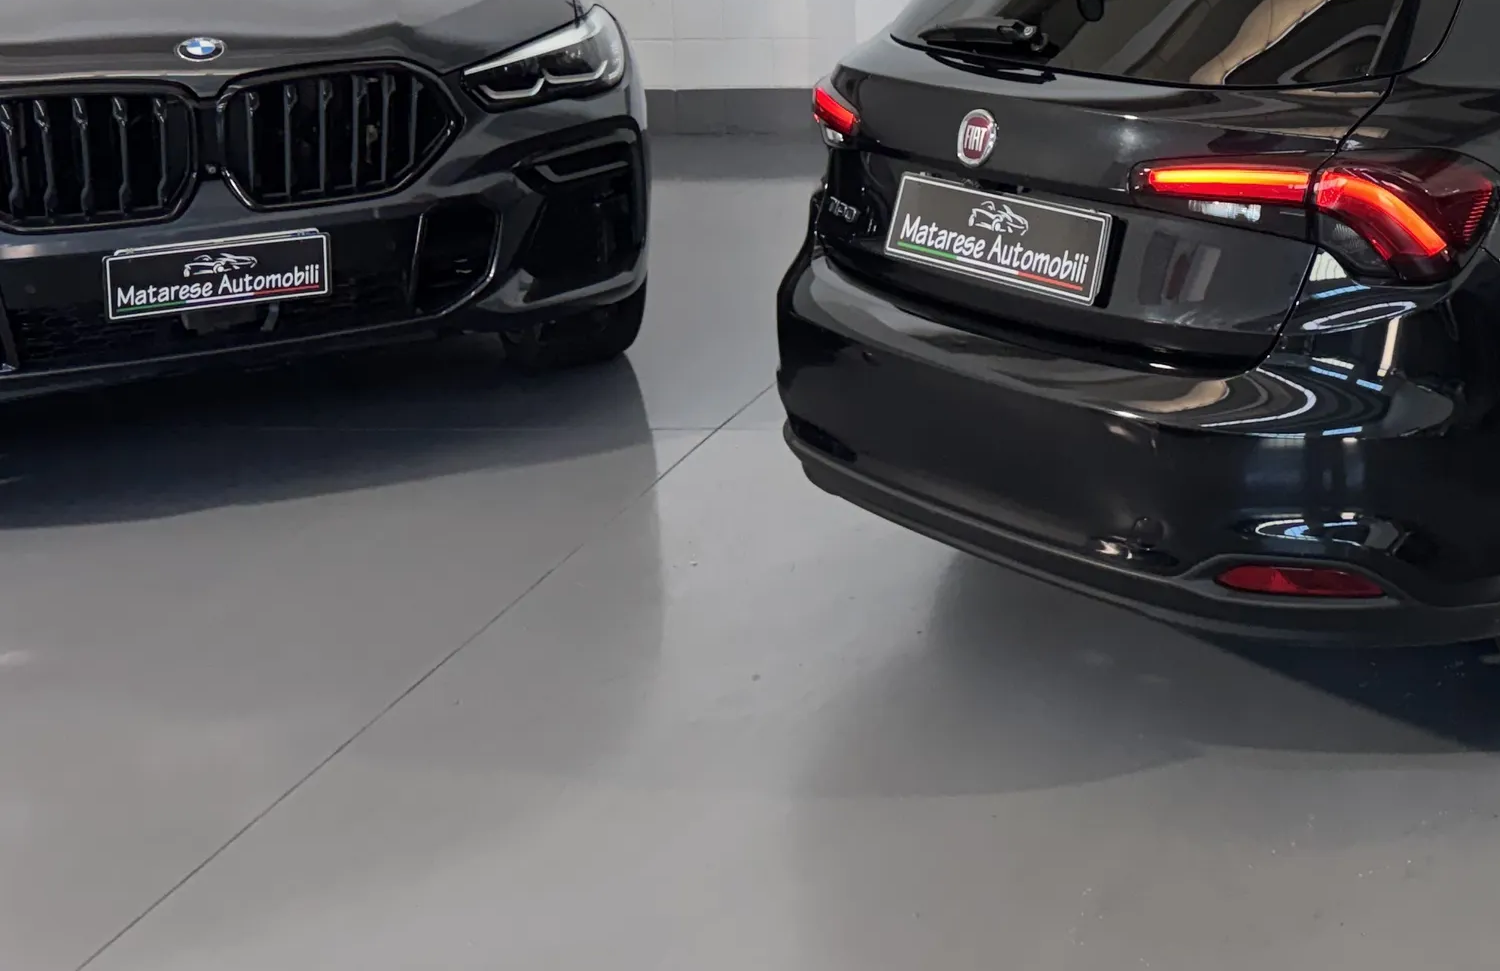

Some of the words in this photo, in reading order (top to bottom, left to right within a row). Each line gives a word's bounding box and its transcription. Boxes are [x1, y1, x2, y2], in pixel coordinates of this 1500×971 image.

[964, 124, 988, 151] FIAT
[900, 213, 986, 260] Matarese
[987, 234, 1090, 284] Automobili
[117, 280, 214, 308] Matarese
[217, 264, 320, 295] Automobili
